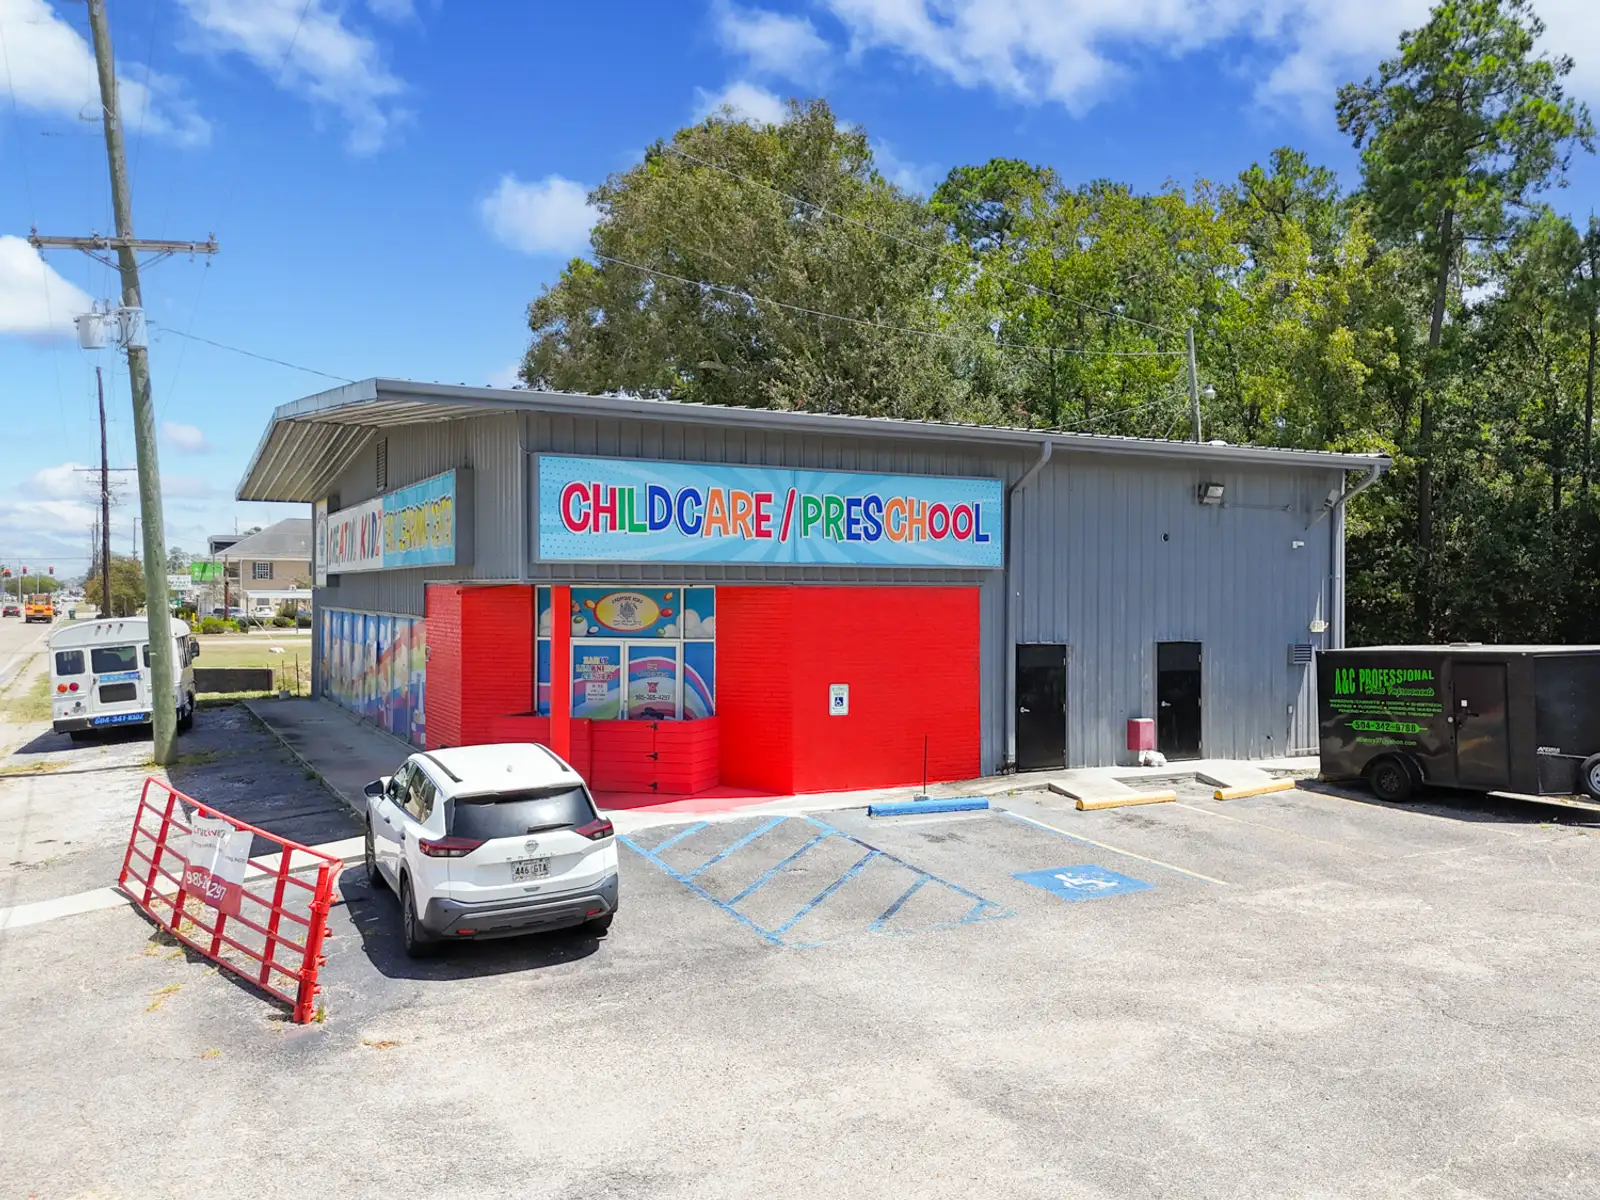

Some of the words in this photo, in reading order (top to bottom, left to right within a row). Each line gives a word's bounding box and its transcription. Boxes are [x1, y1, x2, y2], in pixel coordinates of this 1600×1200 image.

[1335, 668, 1356, 694] A&C
[1358, 668, 1434, 692] PROFESSIONAL
[1355, 721, 1417, 732] 504-342-9788
[515, 866, 530, 876] 446
[533, 864, 548, 872] GTA
